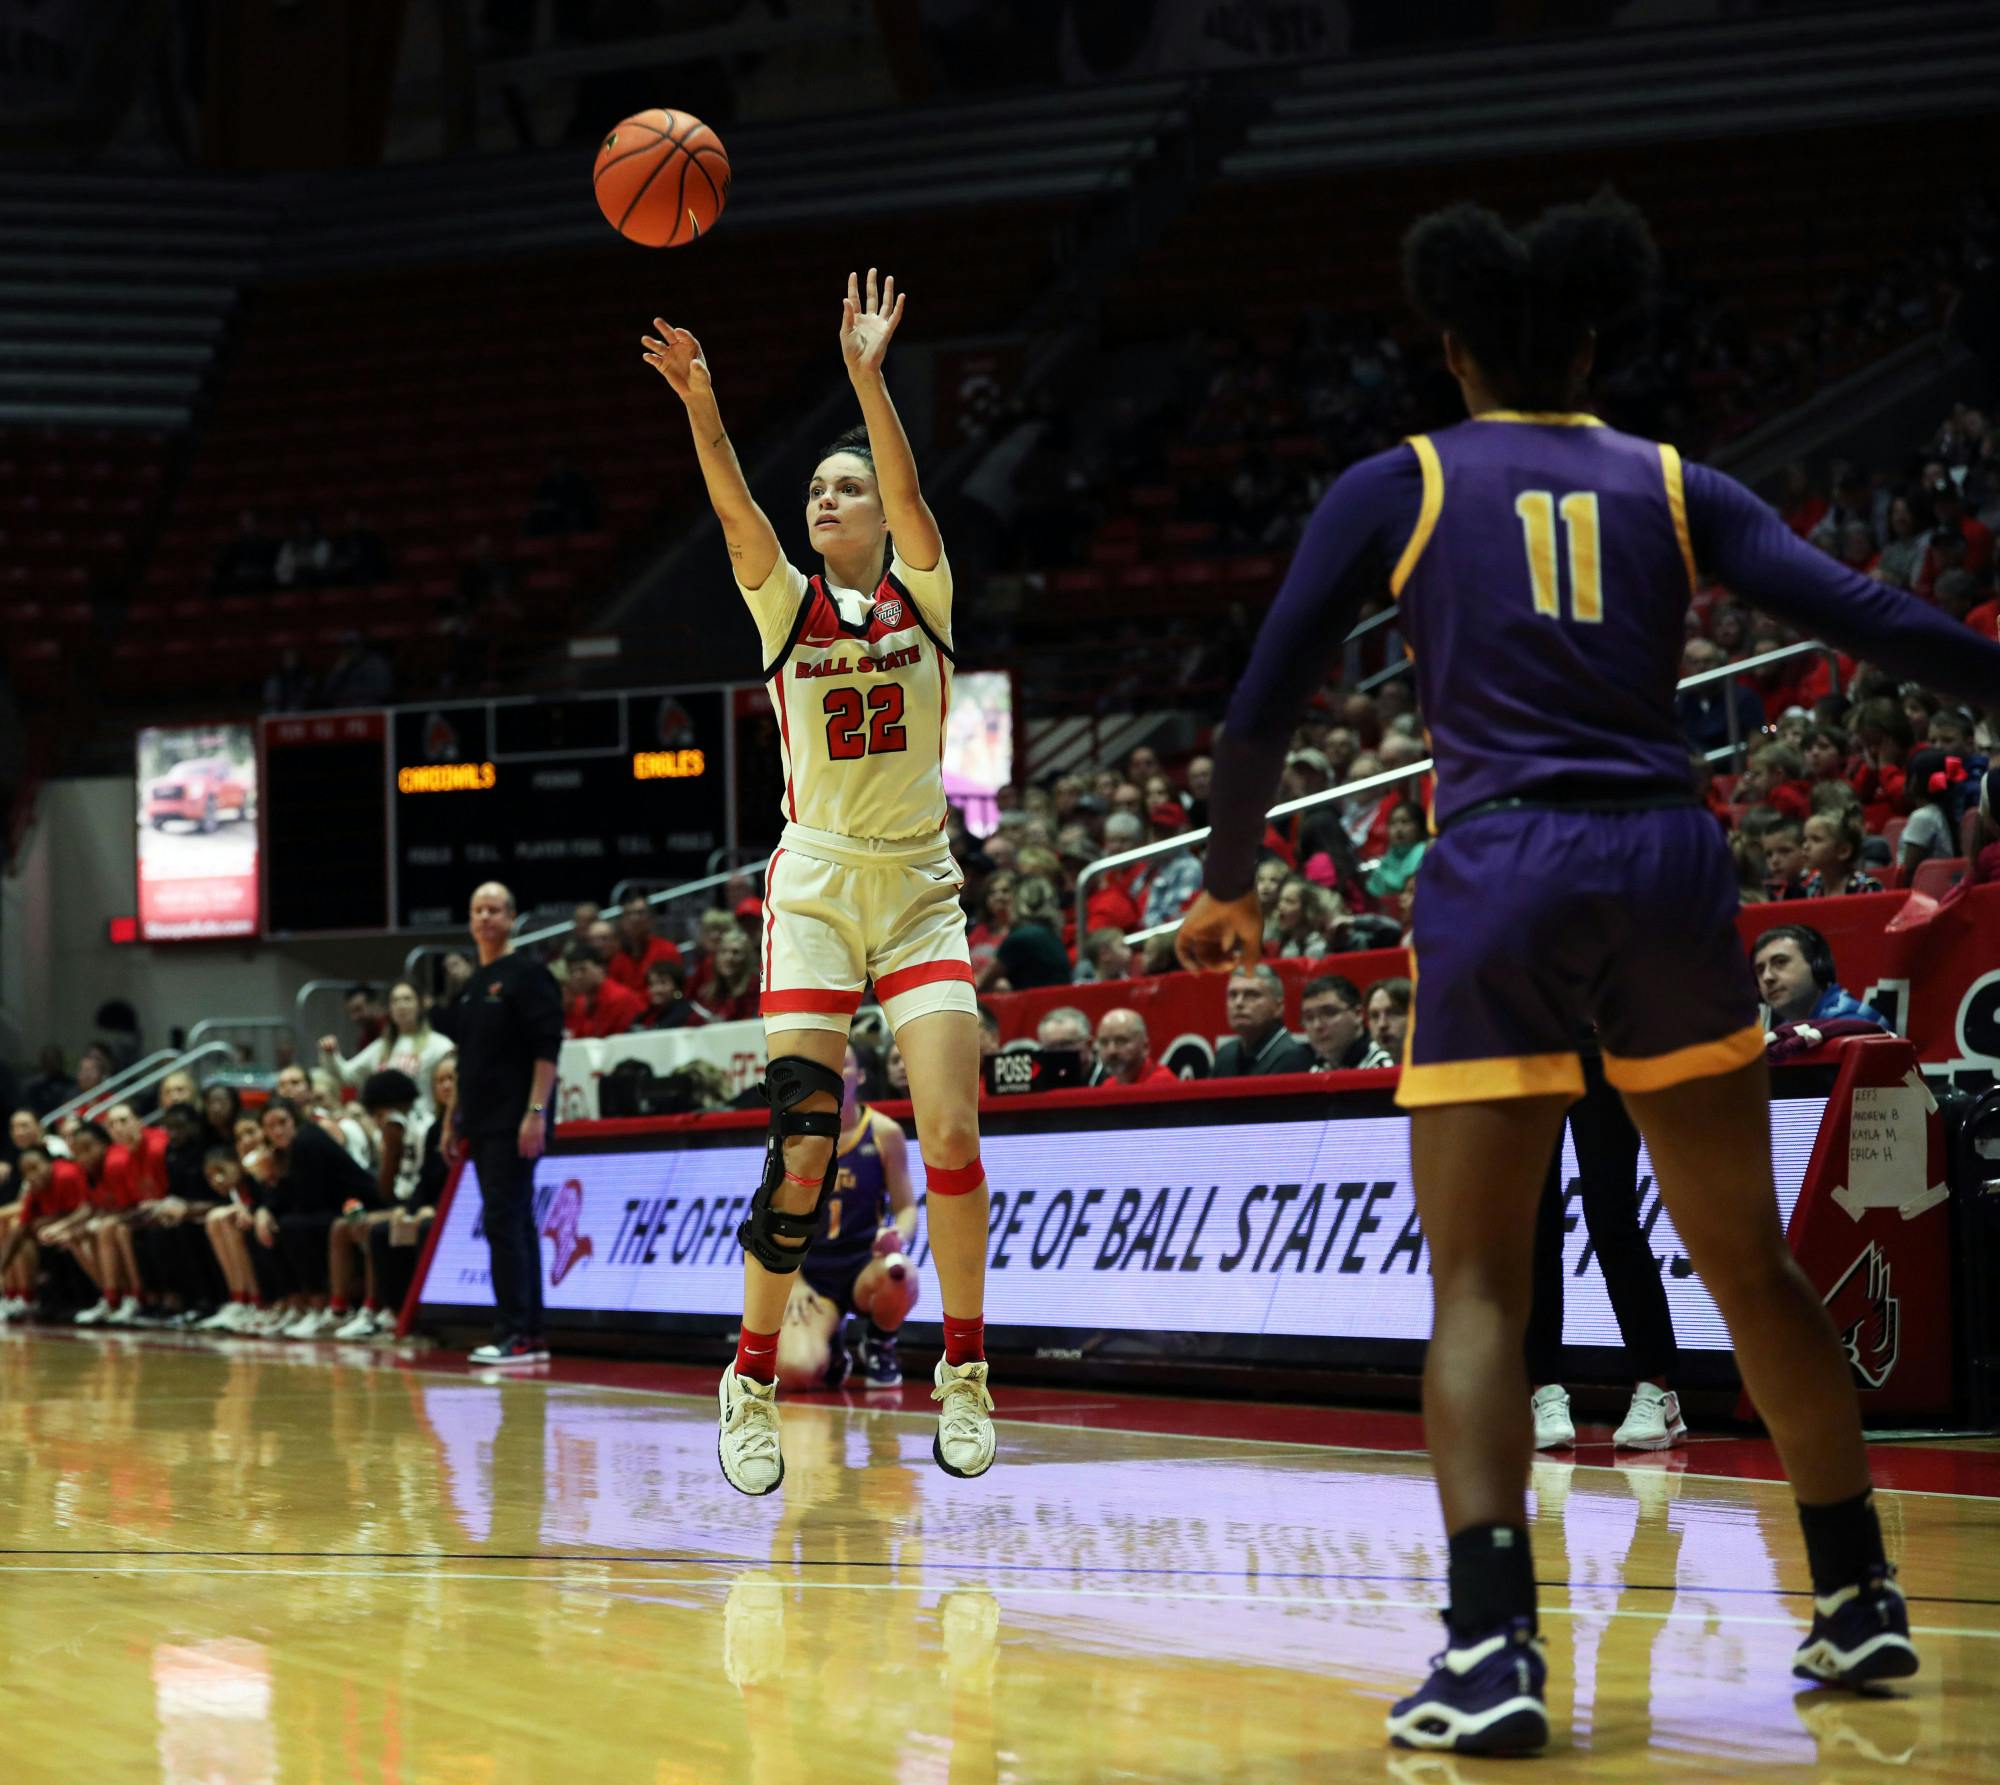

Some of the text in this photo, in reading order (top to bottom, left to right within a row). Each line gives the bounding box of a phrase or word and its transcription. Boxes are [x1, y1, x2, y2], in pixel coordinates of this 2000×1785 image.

[1514, 489, 1604, 624] 11
[795, 644, 921, 679] BALL STATE
[822, 682, 908, 761] 22
[994, 1053, 1033, 1084] POSS
[1853, 1108, 1900, 1121] ANDREW B
[1851, 1127, 1897, 1142] KAYLA M
[1850, 1146, 1893, 1162] ERICA H
[607, 1197, 679, 1265] THE
[1030, 1188, 1107, 1271] OF
[1092, 1185, 1219, 1272] BALL
[1218, 1181, 1398, 1274] STATE
